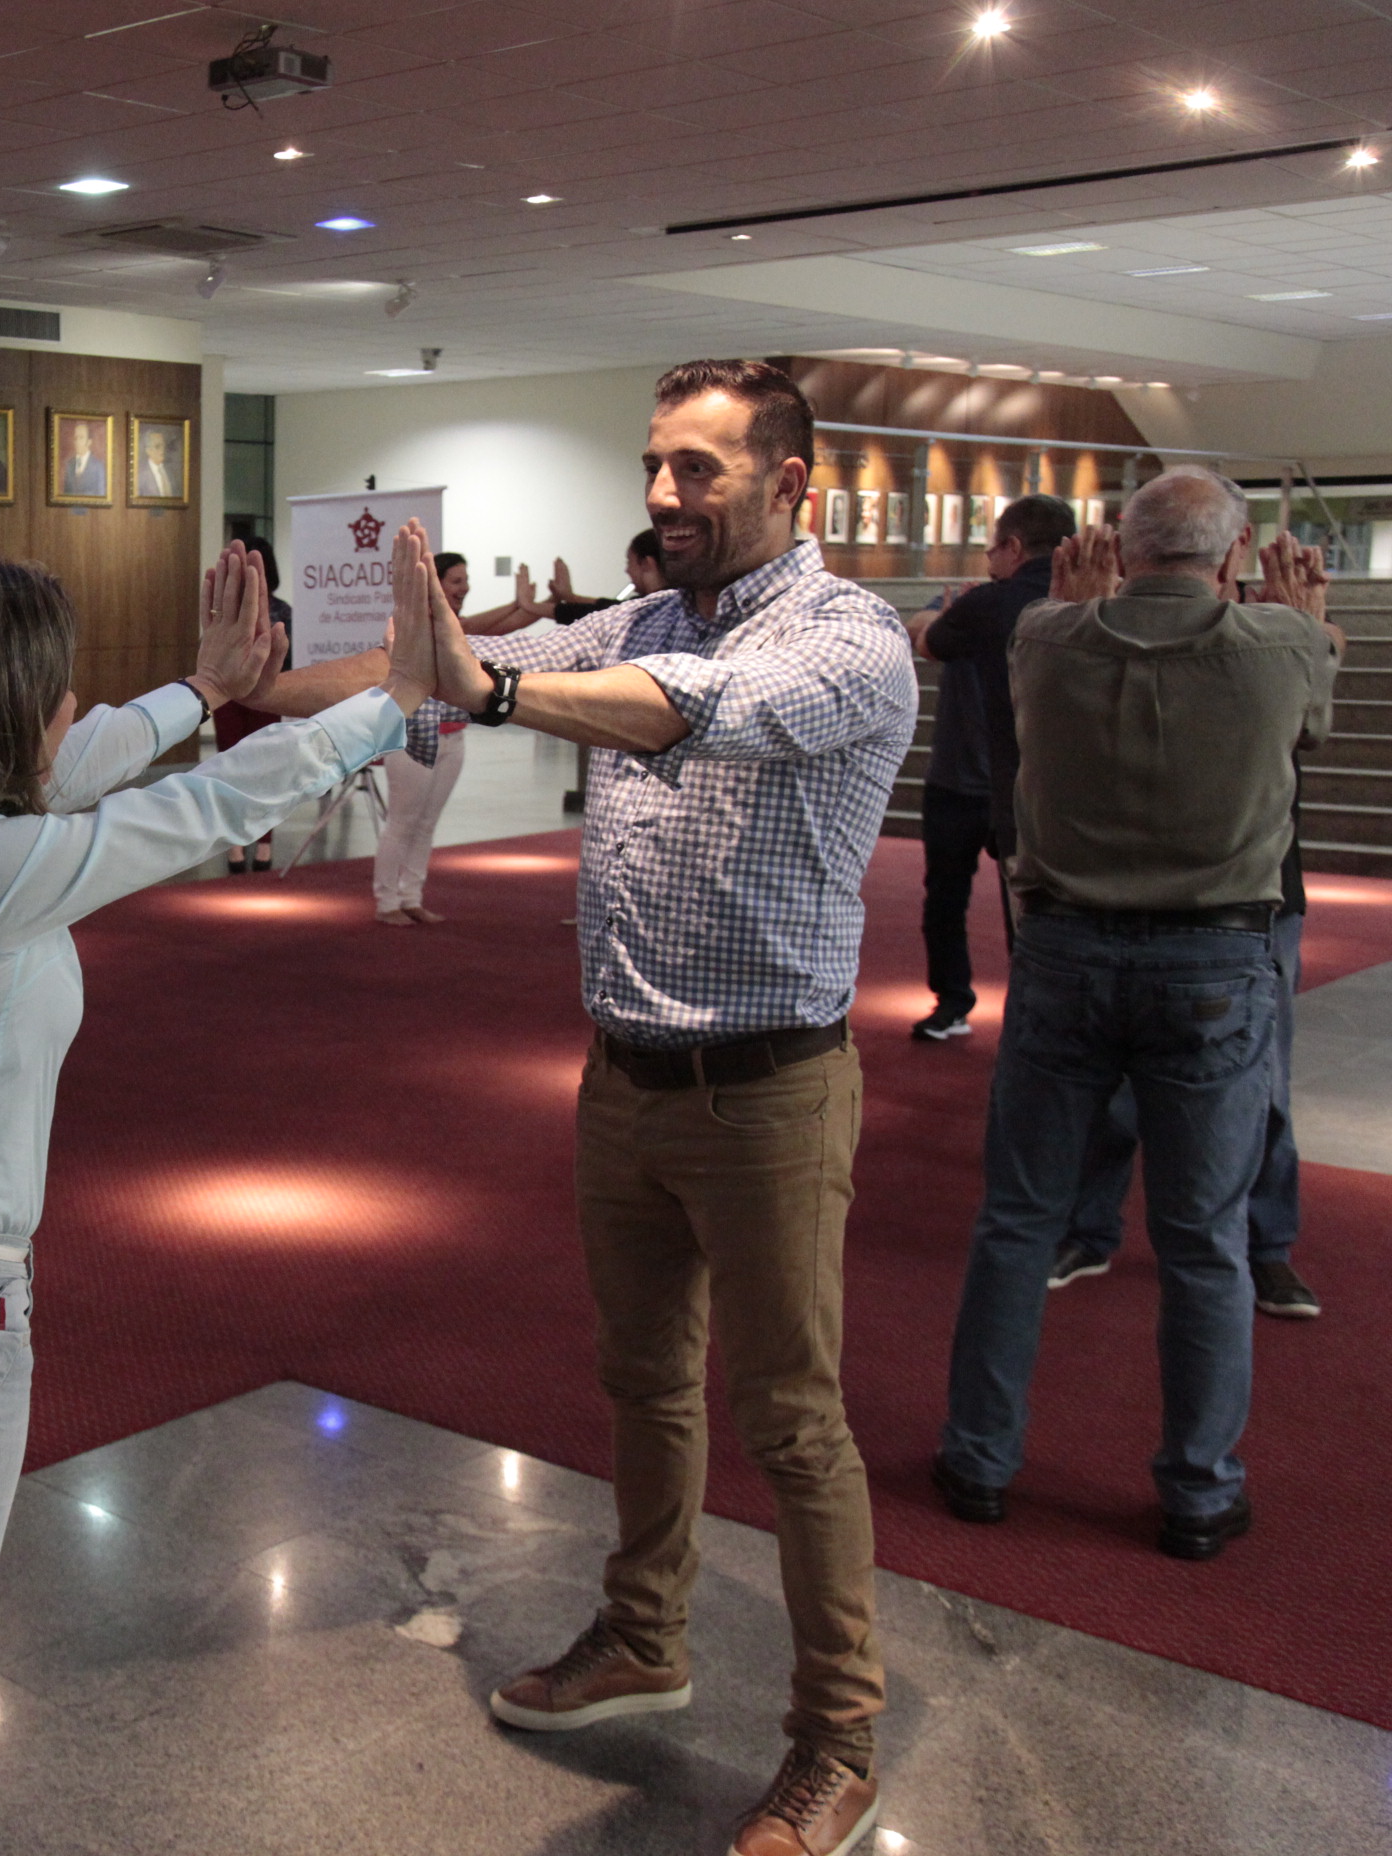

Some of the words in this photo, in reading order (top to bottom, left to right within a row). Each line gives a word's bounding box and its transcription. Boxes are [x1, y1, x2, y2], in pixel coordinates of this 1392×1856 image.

[326, 592, 371, 606] Sindicato
[319, 611, 331, 623] de
[334, 610, 386, 623] Academias
[306, 640, 340, 655] UNIÃO
[342, 641, 364, 654] DAS
